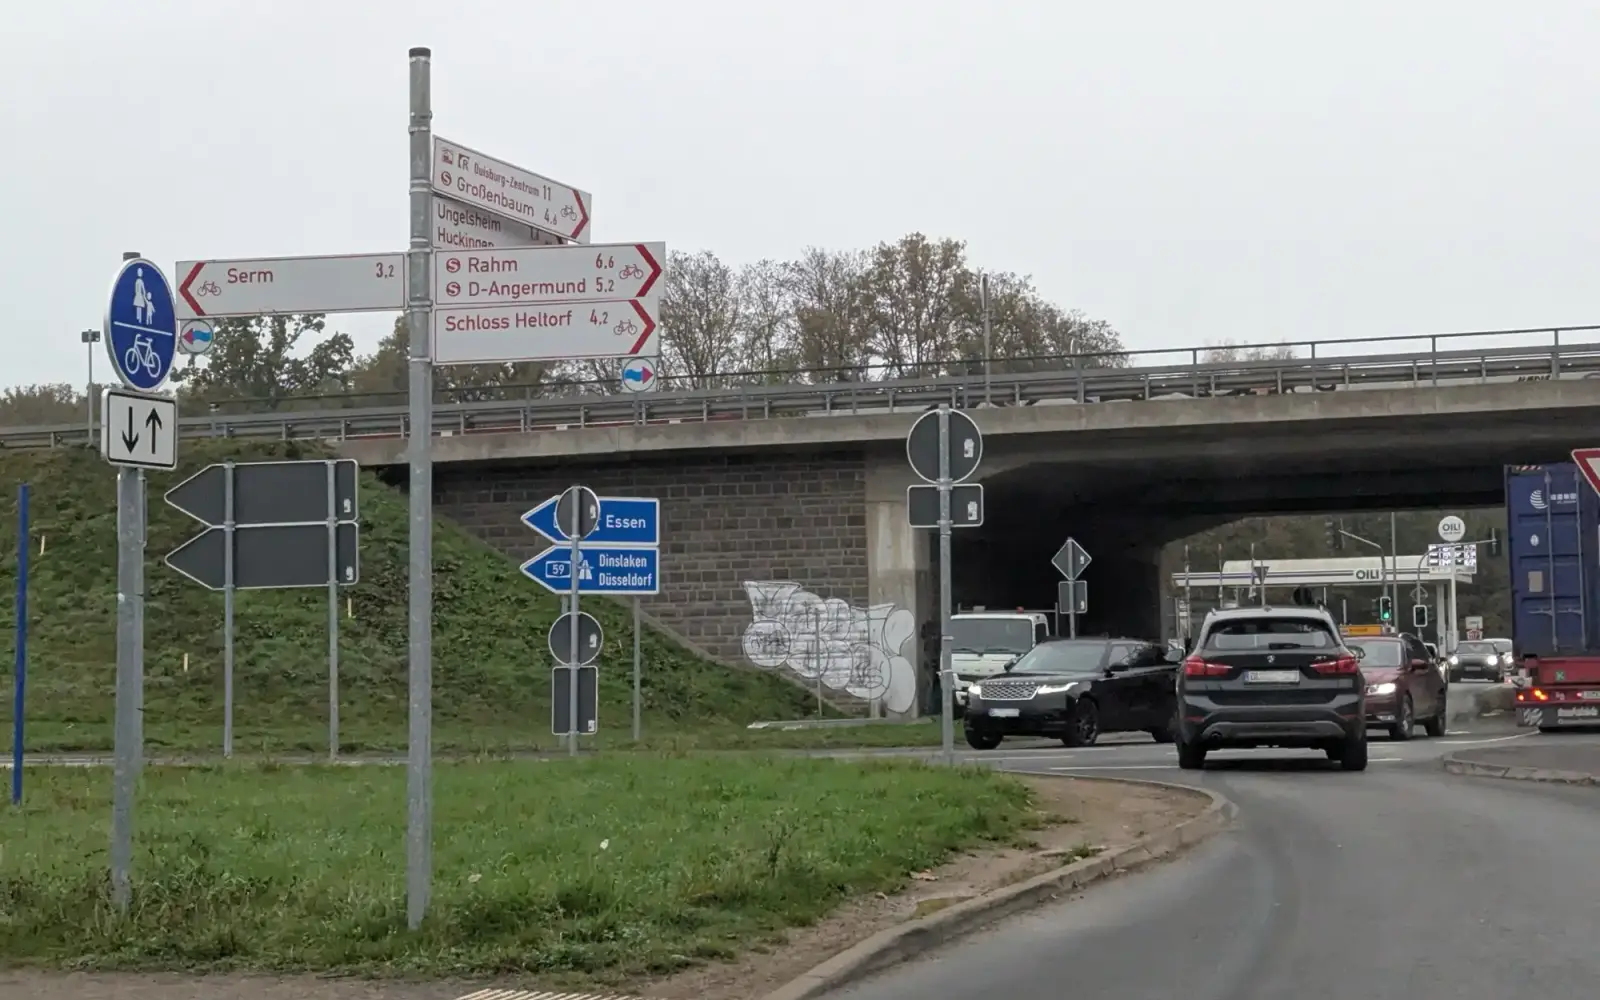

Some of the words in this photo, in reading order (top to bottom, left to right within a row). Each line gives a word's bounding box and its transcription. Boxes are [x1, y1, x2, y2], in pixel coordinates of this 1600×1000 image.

[474, 162, 540, 197] Duisburg-Zentrum
[543, 184, 552, 202] 11
[457, 177, 535, 217] Großenbaum
[437, 203, 501, 232] Ungelsheim
[227, 268, 274, 284] Serm
[375, 262, 395, 279] 3,2
[468, 257, 518, 273] Rahm
[595, 253, 615, 269] 6,6
[468, 278, 586, 299] D-Angermund
[595, 278, 615, 293] 5,2
[445, 315, 510, 332] Schloss
[515, 311, 573, 329] Heltorf
[589, 309, 609, 325] 4,2
[606, 515, 646, 529] Essen
[552, 564, 565, 575] 59
[599, 554, 647, 567] Dinslaken
[599, 572, 652, 586] Düsseldorf
